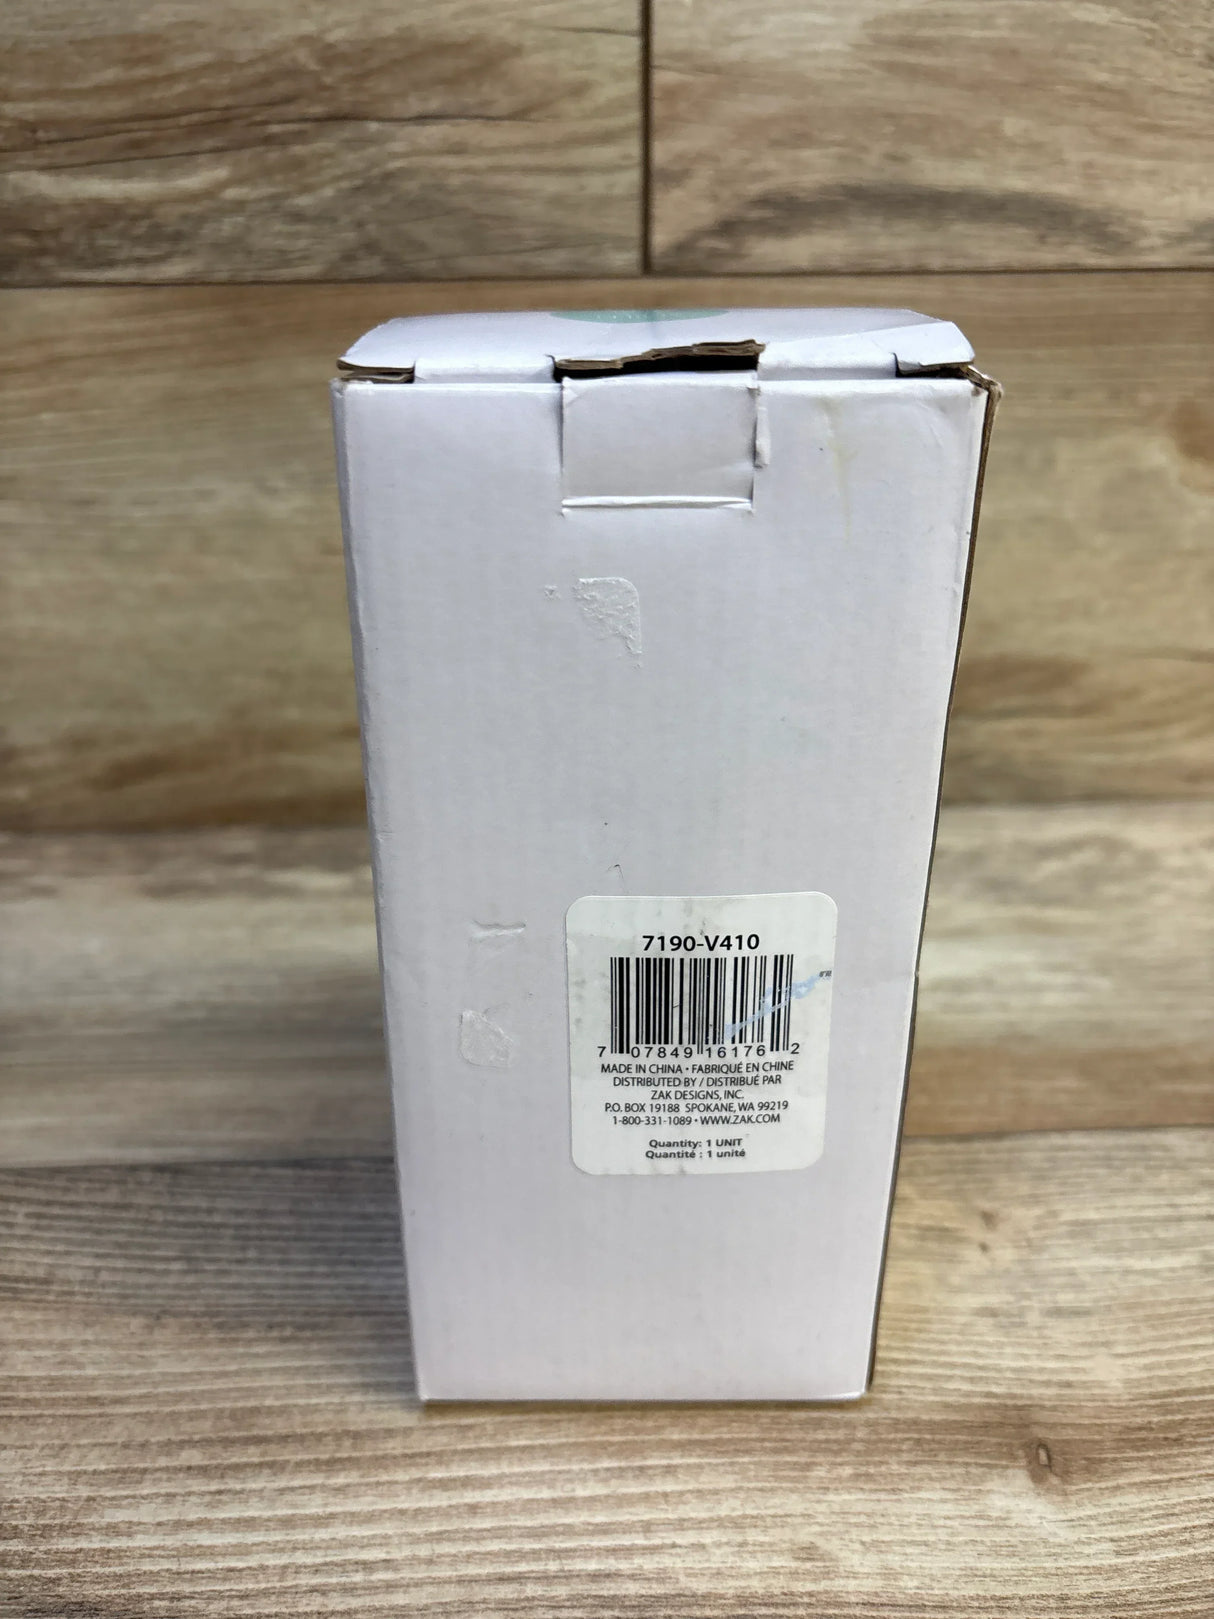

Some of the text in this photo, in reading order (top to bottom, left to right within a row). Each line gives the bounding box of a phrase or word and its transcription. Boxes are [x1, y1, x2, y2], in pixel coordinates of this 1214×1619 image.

[642, 934, 760, 951] 7190-V410
[597, 1043, 800, 1058] 7 07849 16176 2
[601, 1061, 794, 1075] MADE IN CHINA FABRIQUÉ EN CHINE
[613, 1077, 681, 1086] DISTRIBUTED
[684, 1077, 697, 1086] BY
[707, 1075, 759, 1086] DISTRIBUÉ
[762, 1075, 782, 1084] PAR
[651, 1090, 744, 1100] ZAK DESIGNS, INC.
[605, 1101, 788, 1113] P.O. BOX 19188 SPOKANE, WA 99219
[613, 1114, 780, 1125] 1-800-331-1089 WWW.ZAK.COM
[649, 1138, 743, 1148] Quantity: 1 UNIT
[645, 1150, 696, 1159] Quantité
